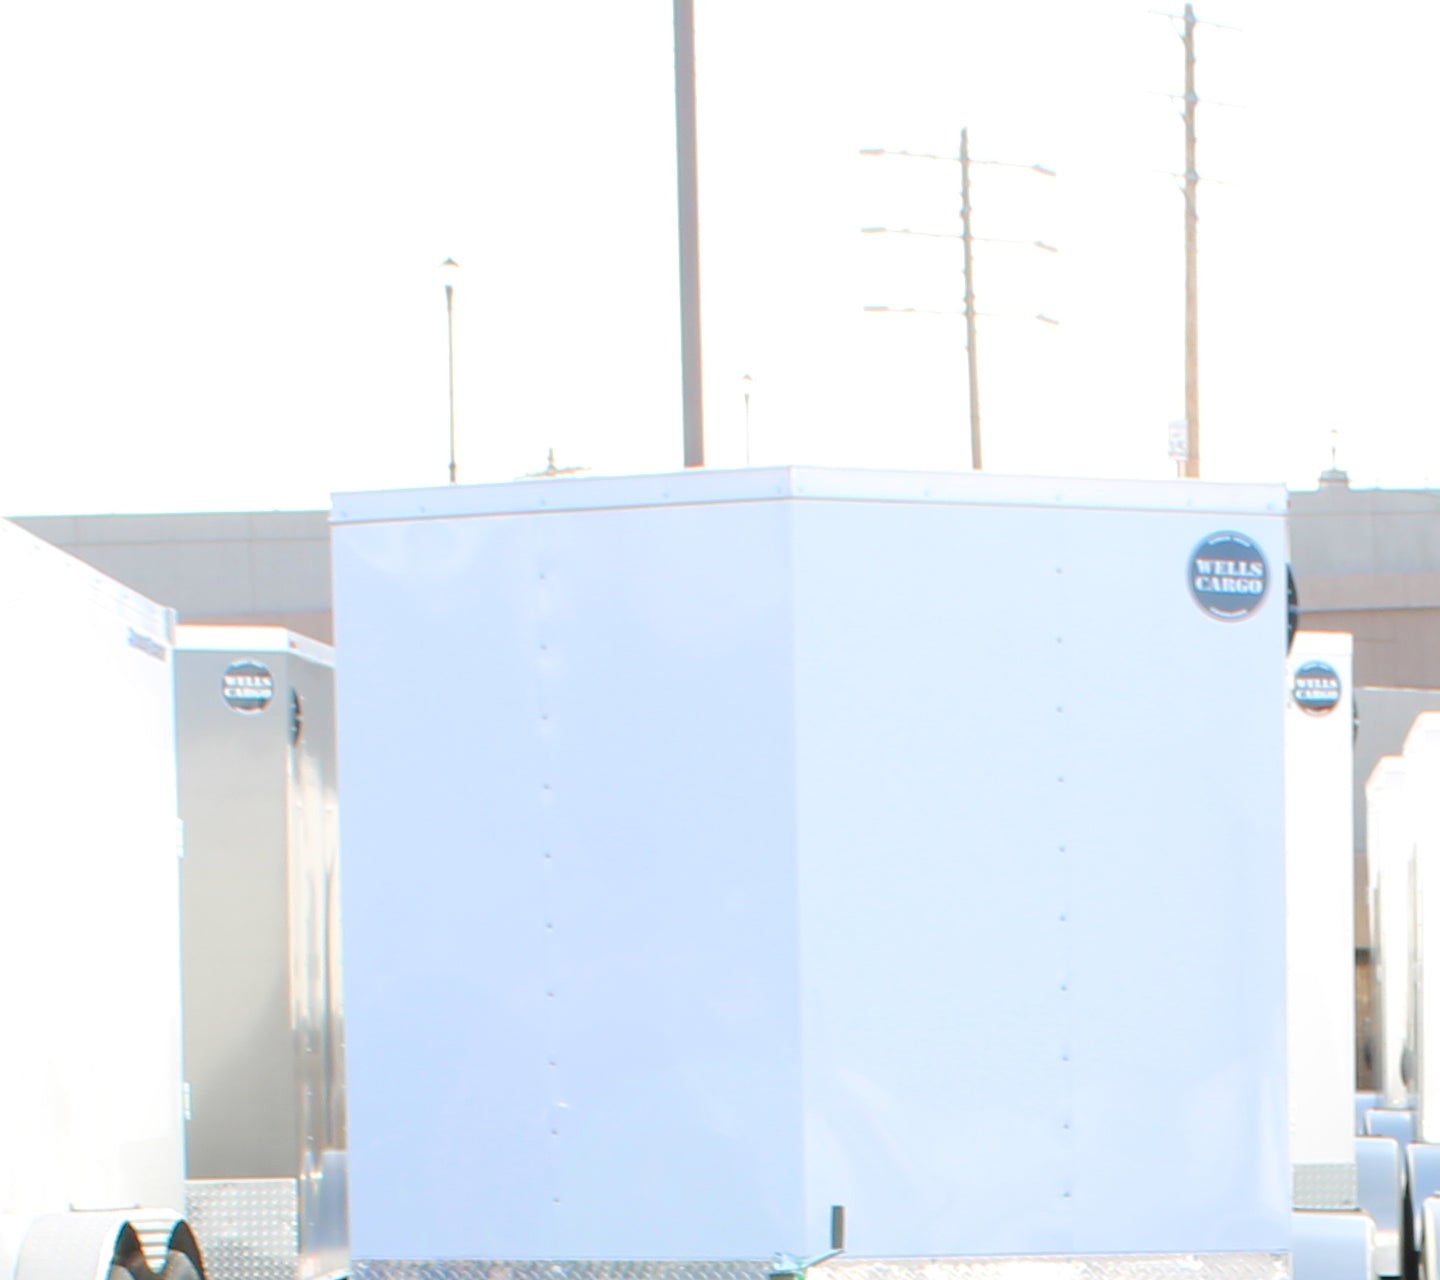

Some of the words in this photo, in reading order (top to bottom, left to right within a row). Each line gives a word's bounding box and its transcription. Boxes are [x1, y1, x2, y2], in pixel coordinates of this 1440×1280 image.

[1195, 559, 1264, 577] WELLS
[1195, 577, 1264, 595] CARGO
[223, 675, 273, 687] WELLS
[1295, 678, 1339, 689] WELLS
[223, 687, 273, 699] CARGO
[1295, 689, 1339, 701] CARGO
